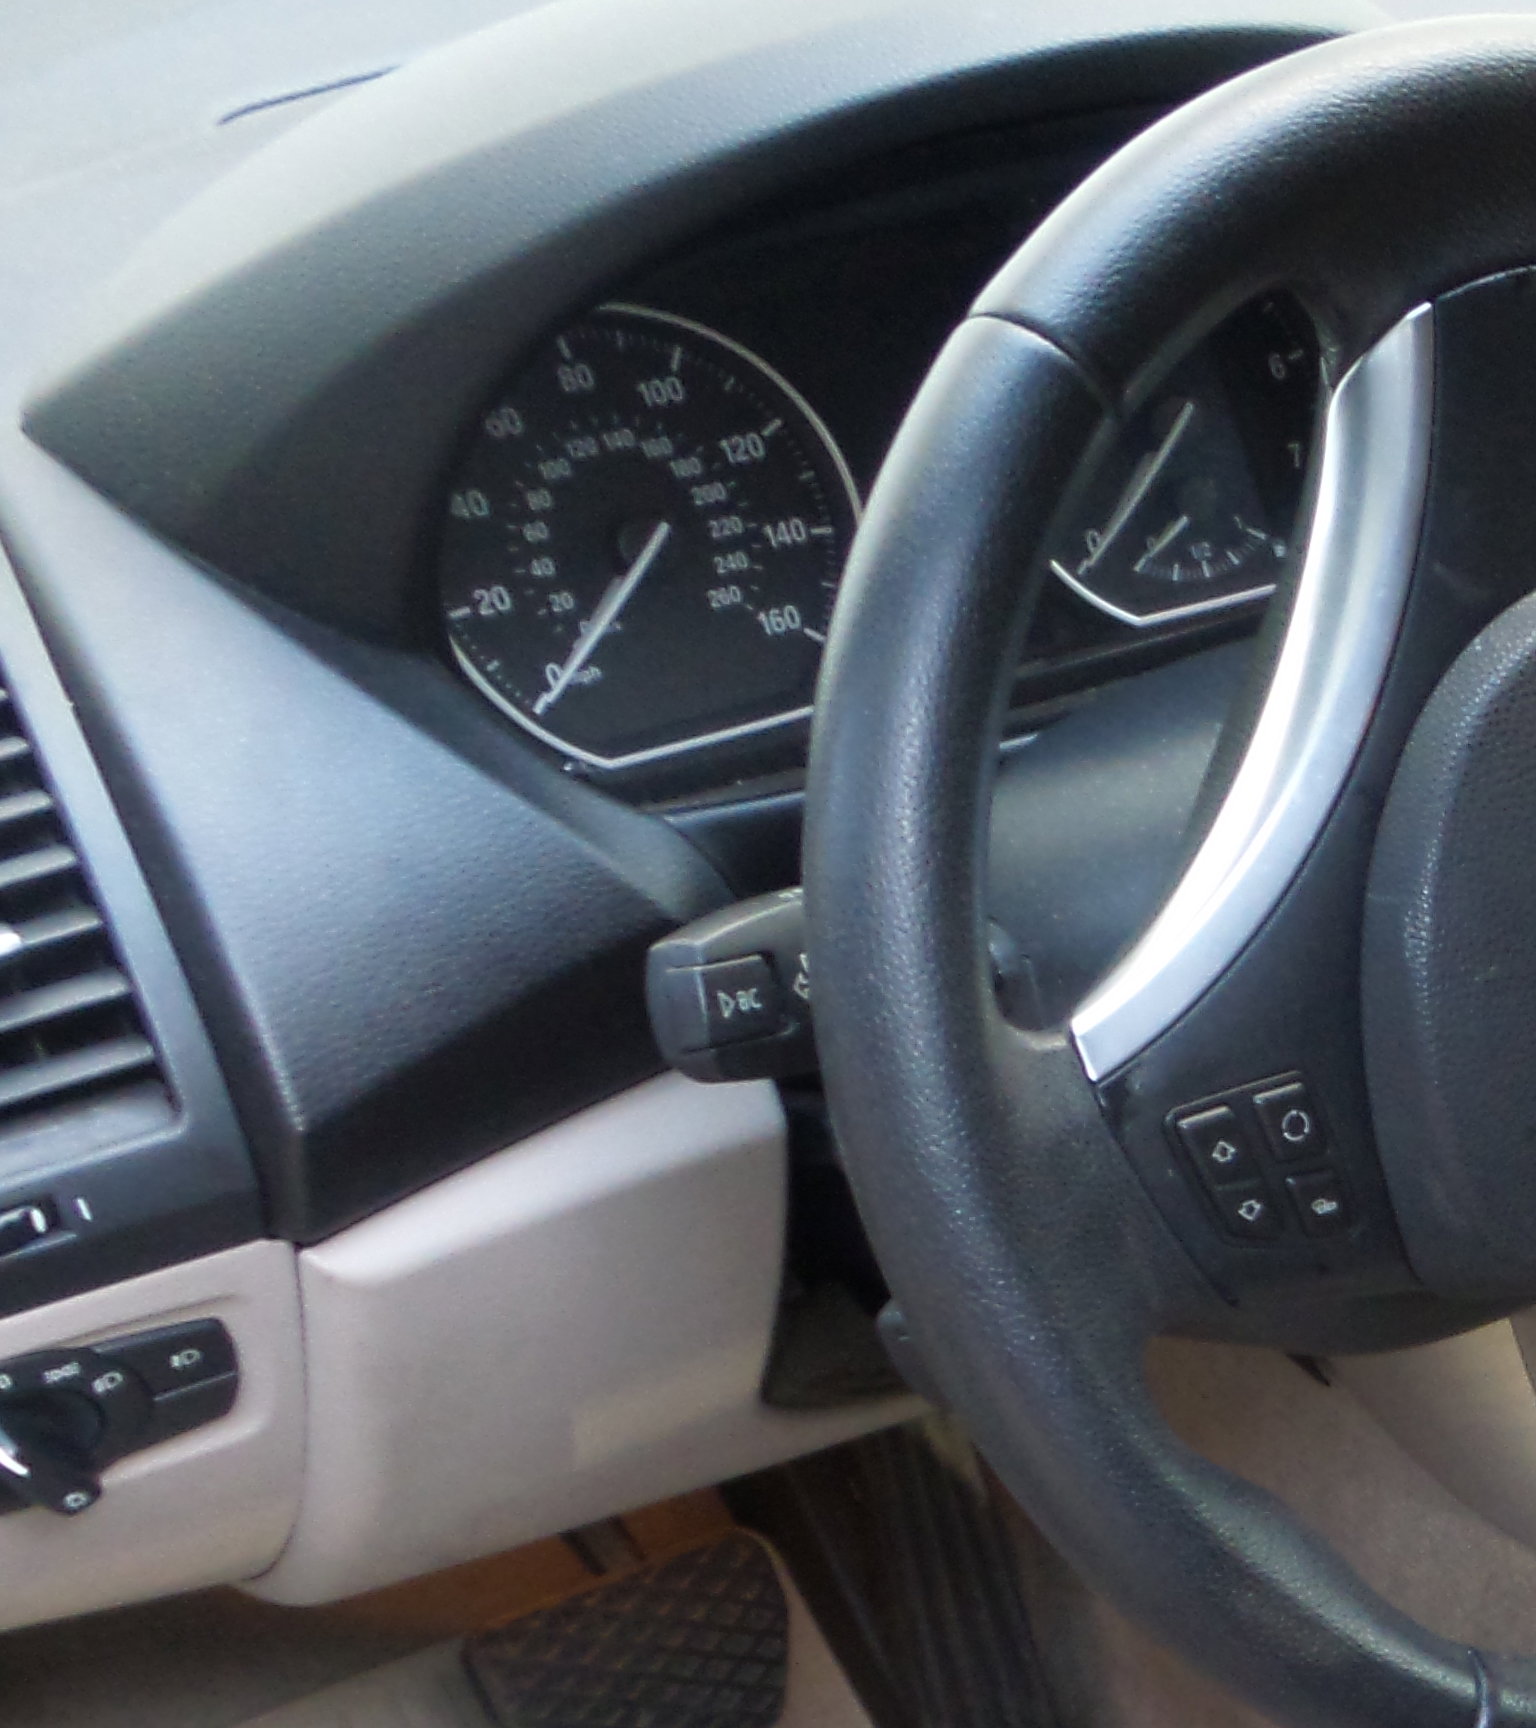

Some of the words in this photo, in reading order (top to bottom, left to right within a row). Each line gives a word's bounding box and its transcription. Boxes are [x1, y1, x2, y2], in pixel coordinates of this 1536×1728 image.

[557, 363, 594, 392] 80
[637, 376, 684, 407] 100
[486, 407, 523, 438] 60
[718, 432, 765, 464] 120
[450, 489, 490, 519] 40
[708, 515, 744, 539] 220
[762, 516, 807, 548] 140
[713, 551, 750, 574] 240
[473, 585, 512, 616] 20
[550, 591, 574, 613] 20
[706, 585, 743, 610] 260
[757, 605, 801, 636] 160
